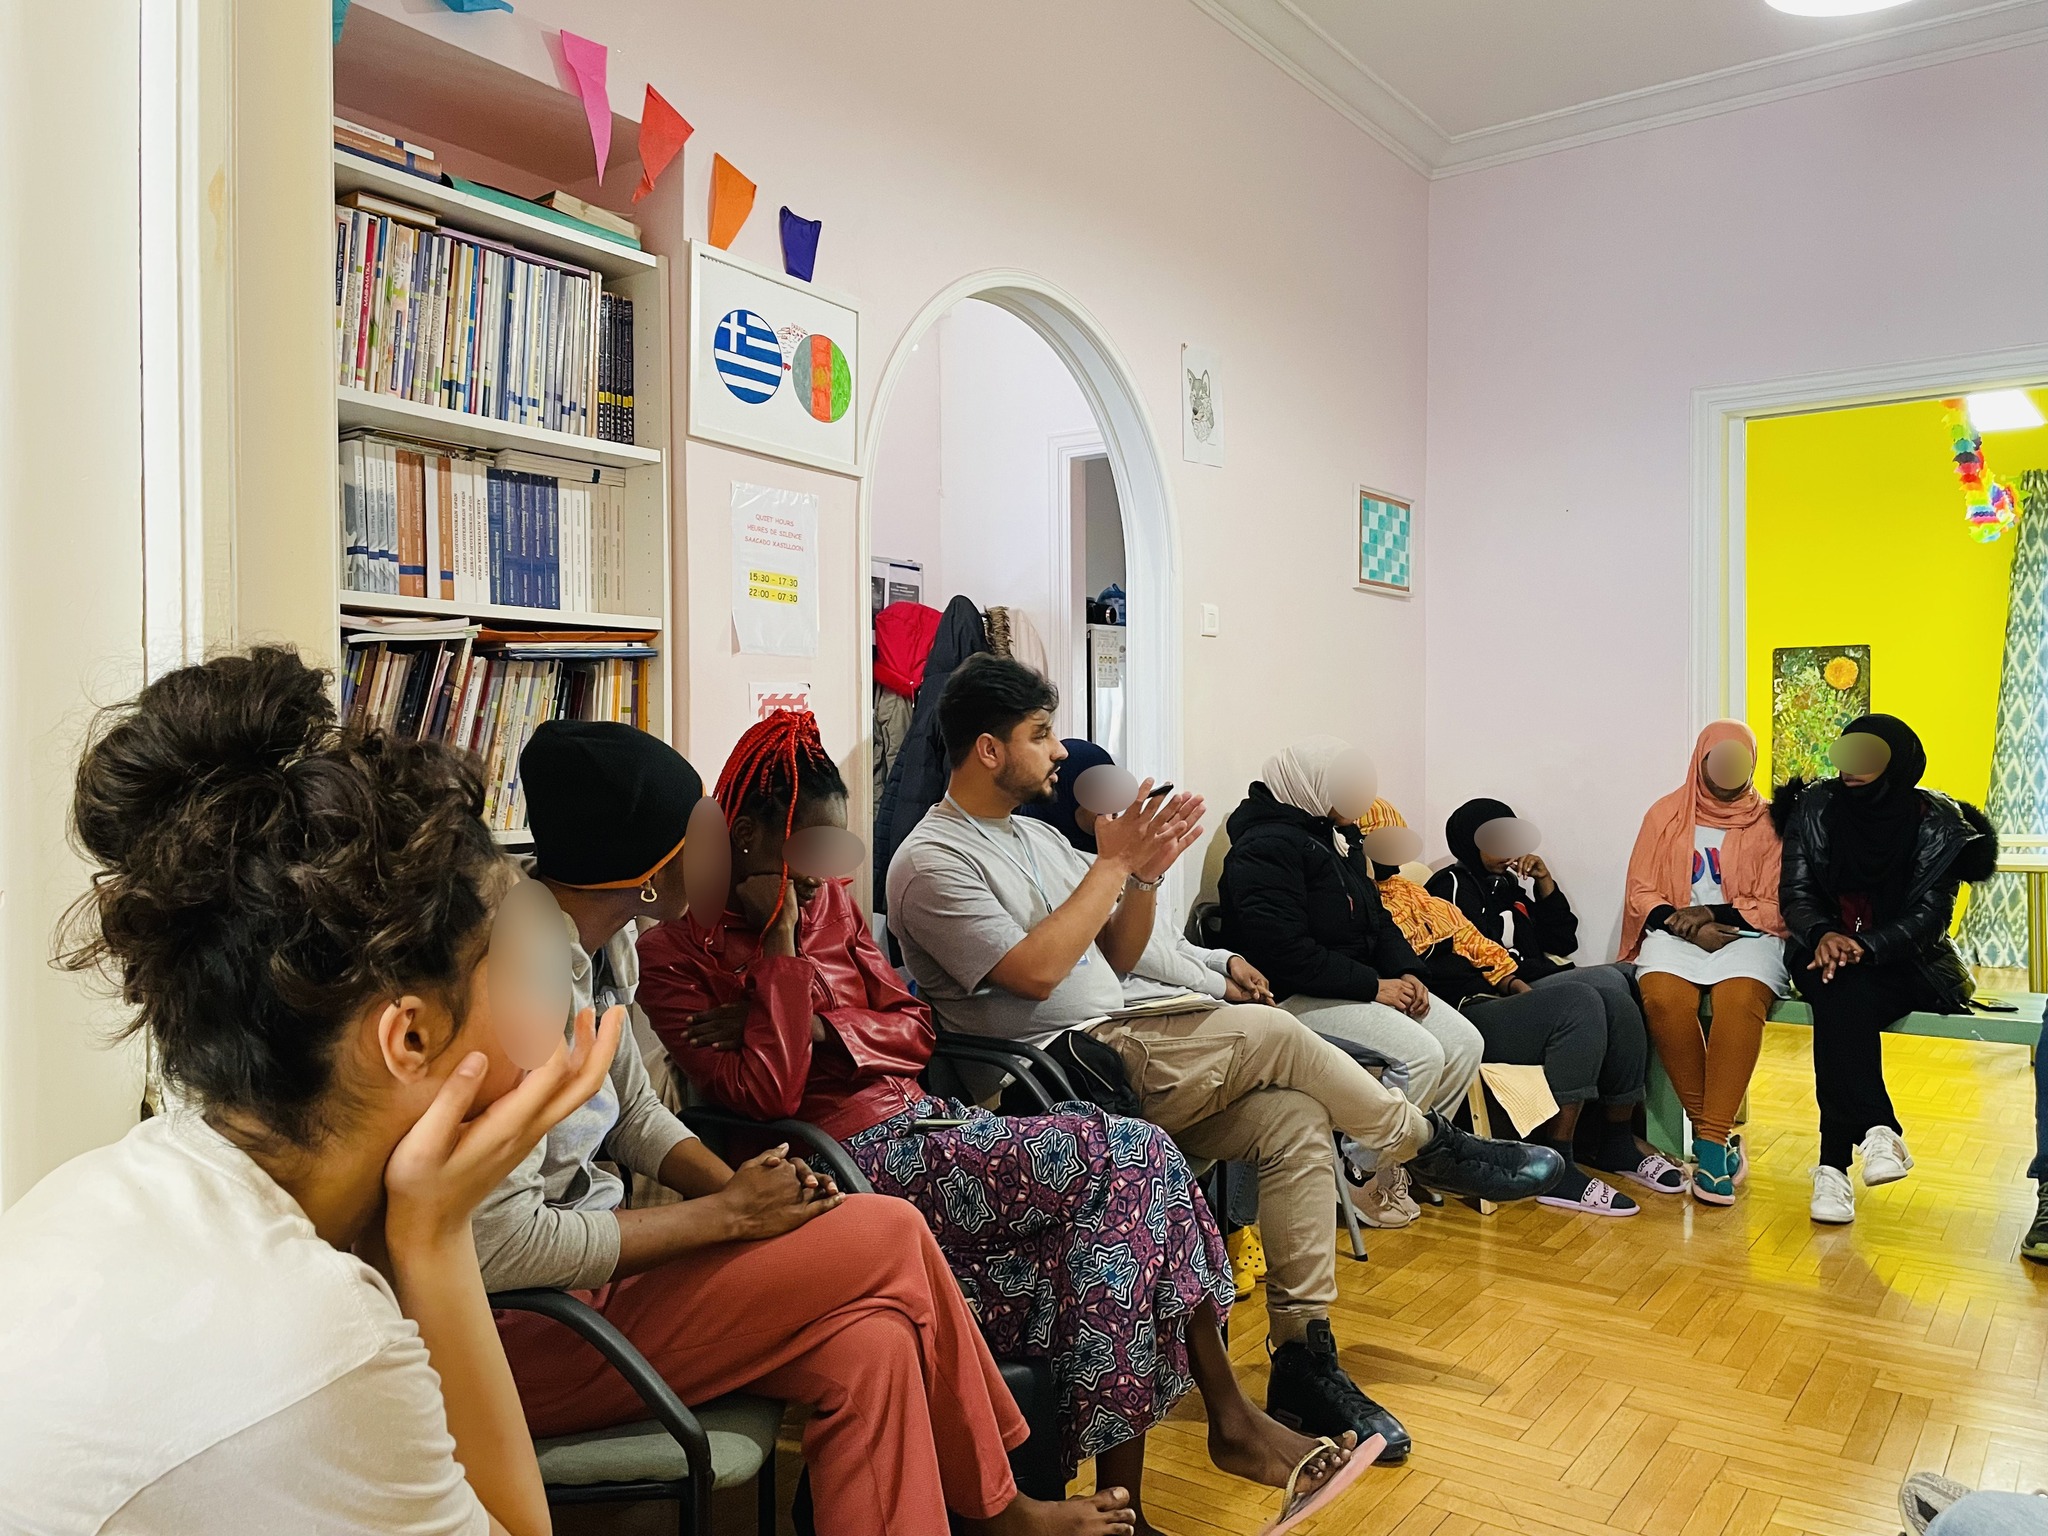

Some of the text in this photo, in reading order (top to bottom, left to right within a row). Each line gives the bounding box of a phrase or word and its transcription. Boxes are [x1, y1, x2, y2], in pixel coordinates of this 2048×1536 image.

[755, 513, 794, 527] QUIET HOURS
[747, 524, 769, 534] HEURES
[779, 530, 802, 540] SILENCE
[744, 535, 804, 552] SAACADO XASILLOON
[750, 572, 770, 583] 15:30
[778, 577, 798, 588] 17:30
[749, 588, 769, 599] 22:00
[778, 592, 798, 603] 07:30
